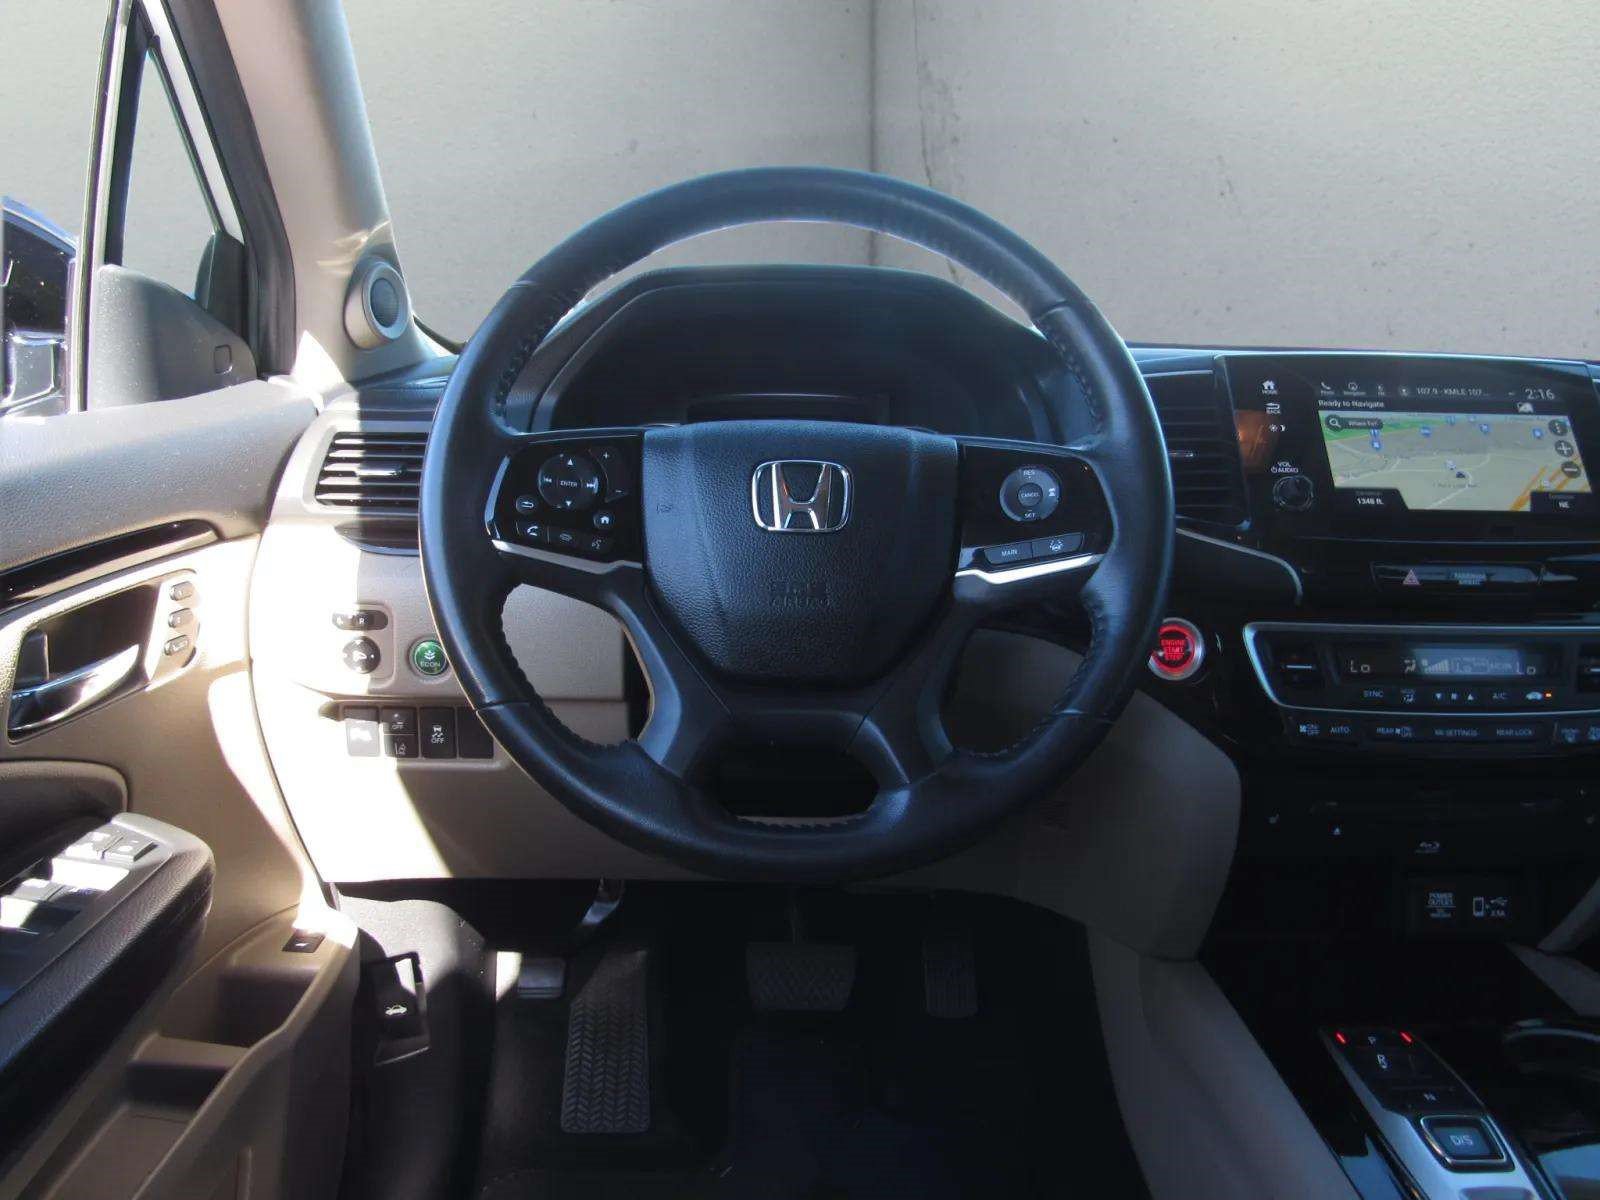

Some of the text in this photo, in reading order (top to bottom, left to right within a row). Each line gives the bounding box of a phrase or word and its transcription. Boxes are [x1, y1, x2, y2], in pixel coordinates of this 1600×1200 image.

[1524, 388, 1556, 400] 2:16
[1318, 399, 1341, 408] Ready
[1352, 400, 1385, 409] Navigate
[559, 480, 578, 488] ENTER
[1001, 549, 1019, 557] MAIN
[358, 616, 365, 625] R
[419, 660, 441, 669] ECON
[1362, 690, 1384, 698] SYNC
[391, 723, 405, 731] OFF
[1329, 727, 1350, 735] AUTO
[1496, 727, 1533, 737] REAR LOCK
[430, 736, 445, 745] OFF
